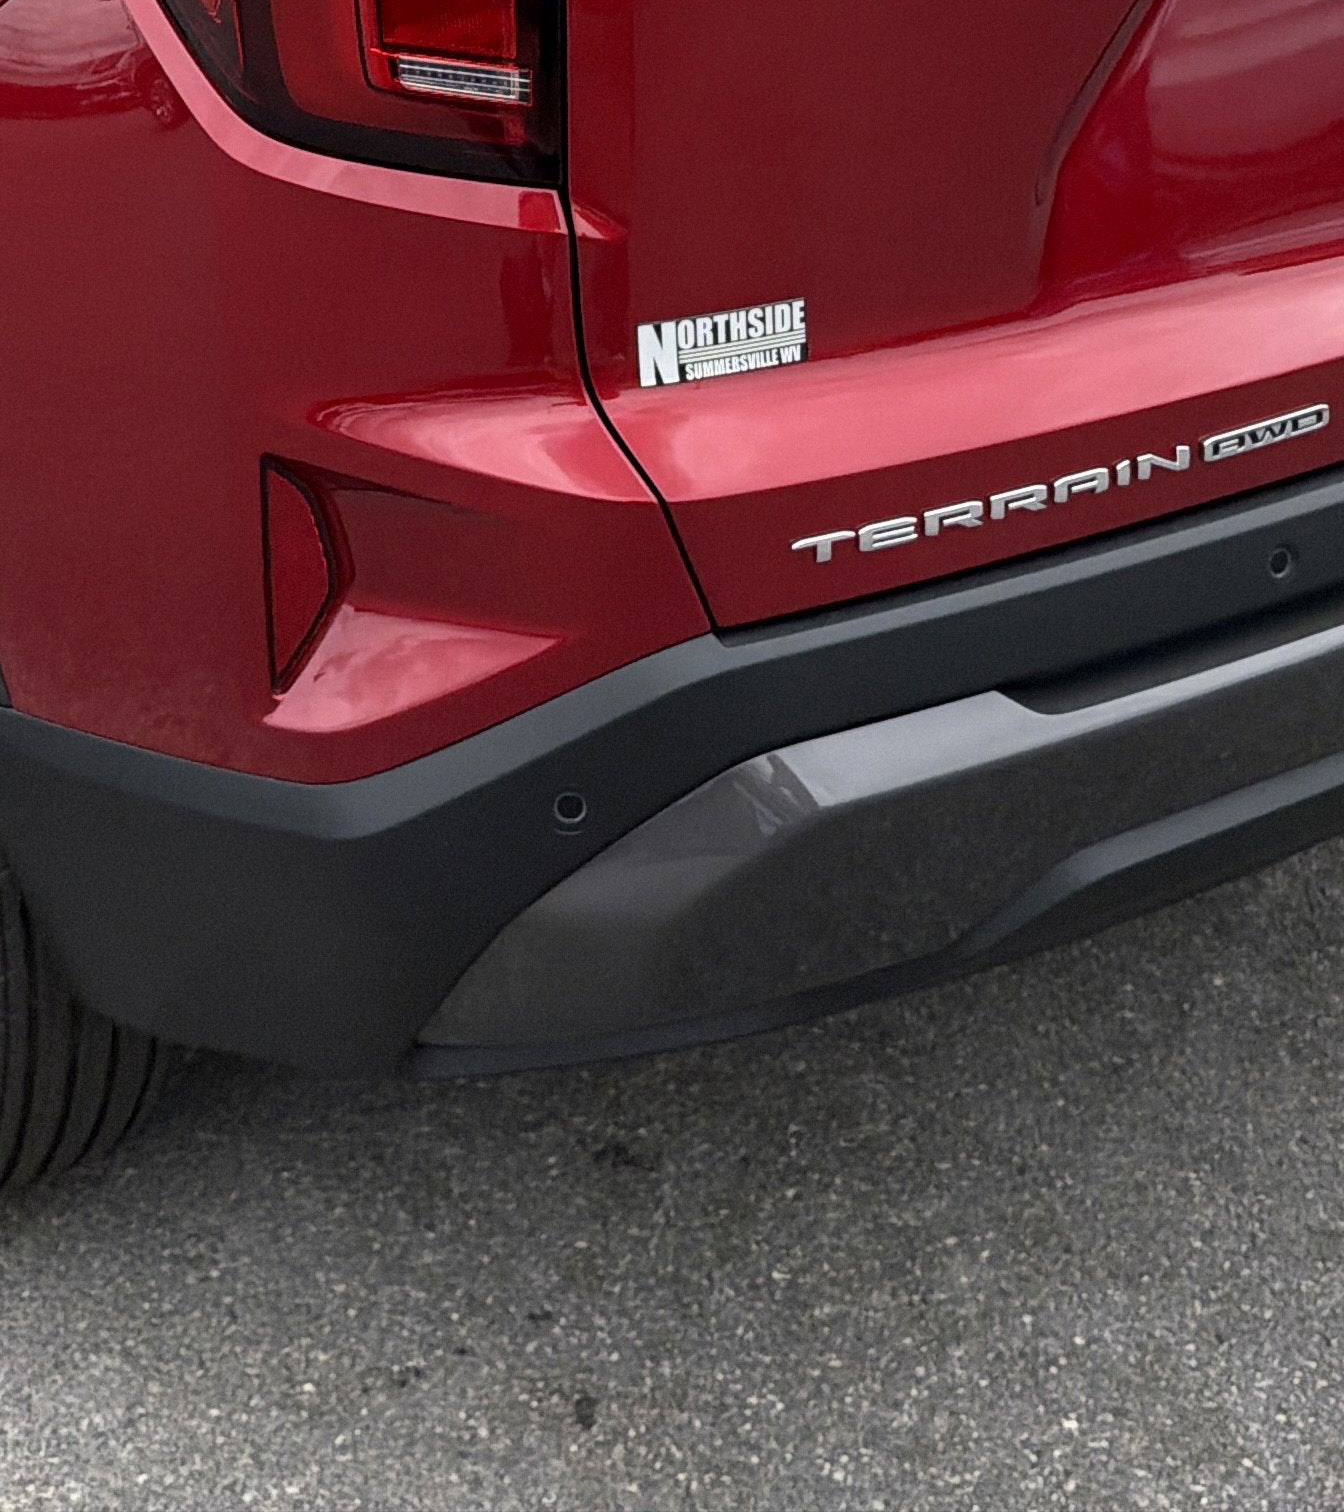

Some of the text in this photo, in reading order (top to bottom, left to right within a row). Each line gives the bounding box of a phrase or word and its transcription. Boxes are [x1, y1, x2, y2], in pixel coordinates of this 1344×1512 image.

[637, 300, 806, 388] NORTHSIDE
[685, 345, 802, 381] SUMMERSVILLE WV
[791, 405, 1328, 564] TERRAIN AWD
